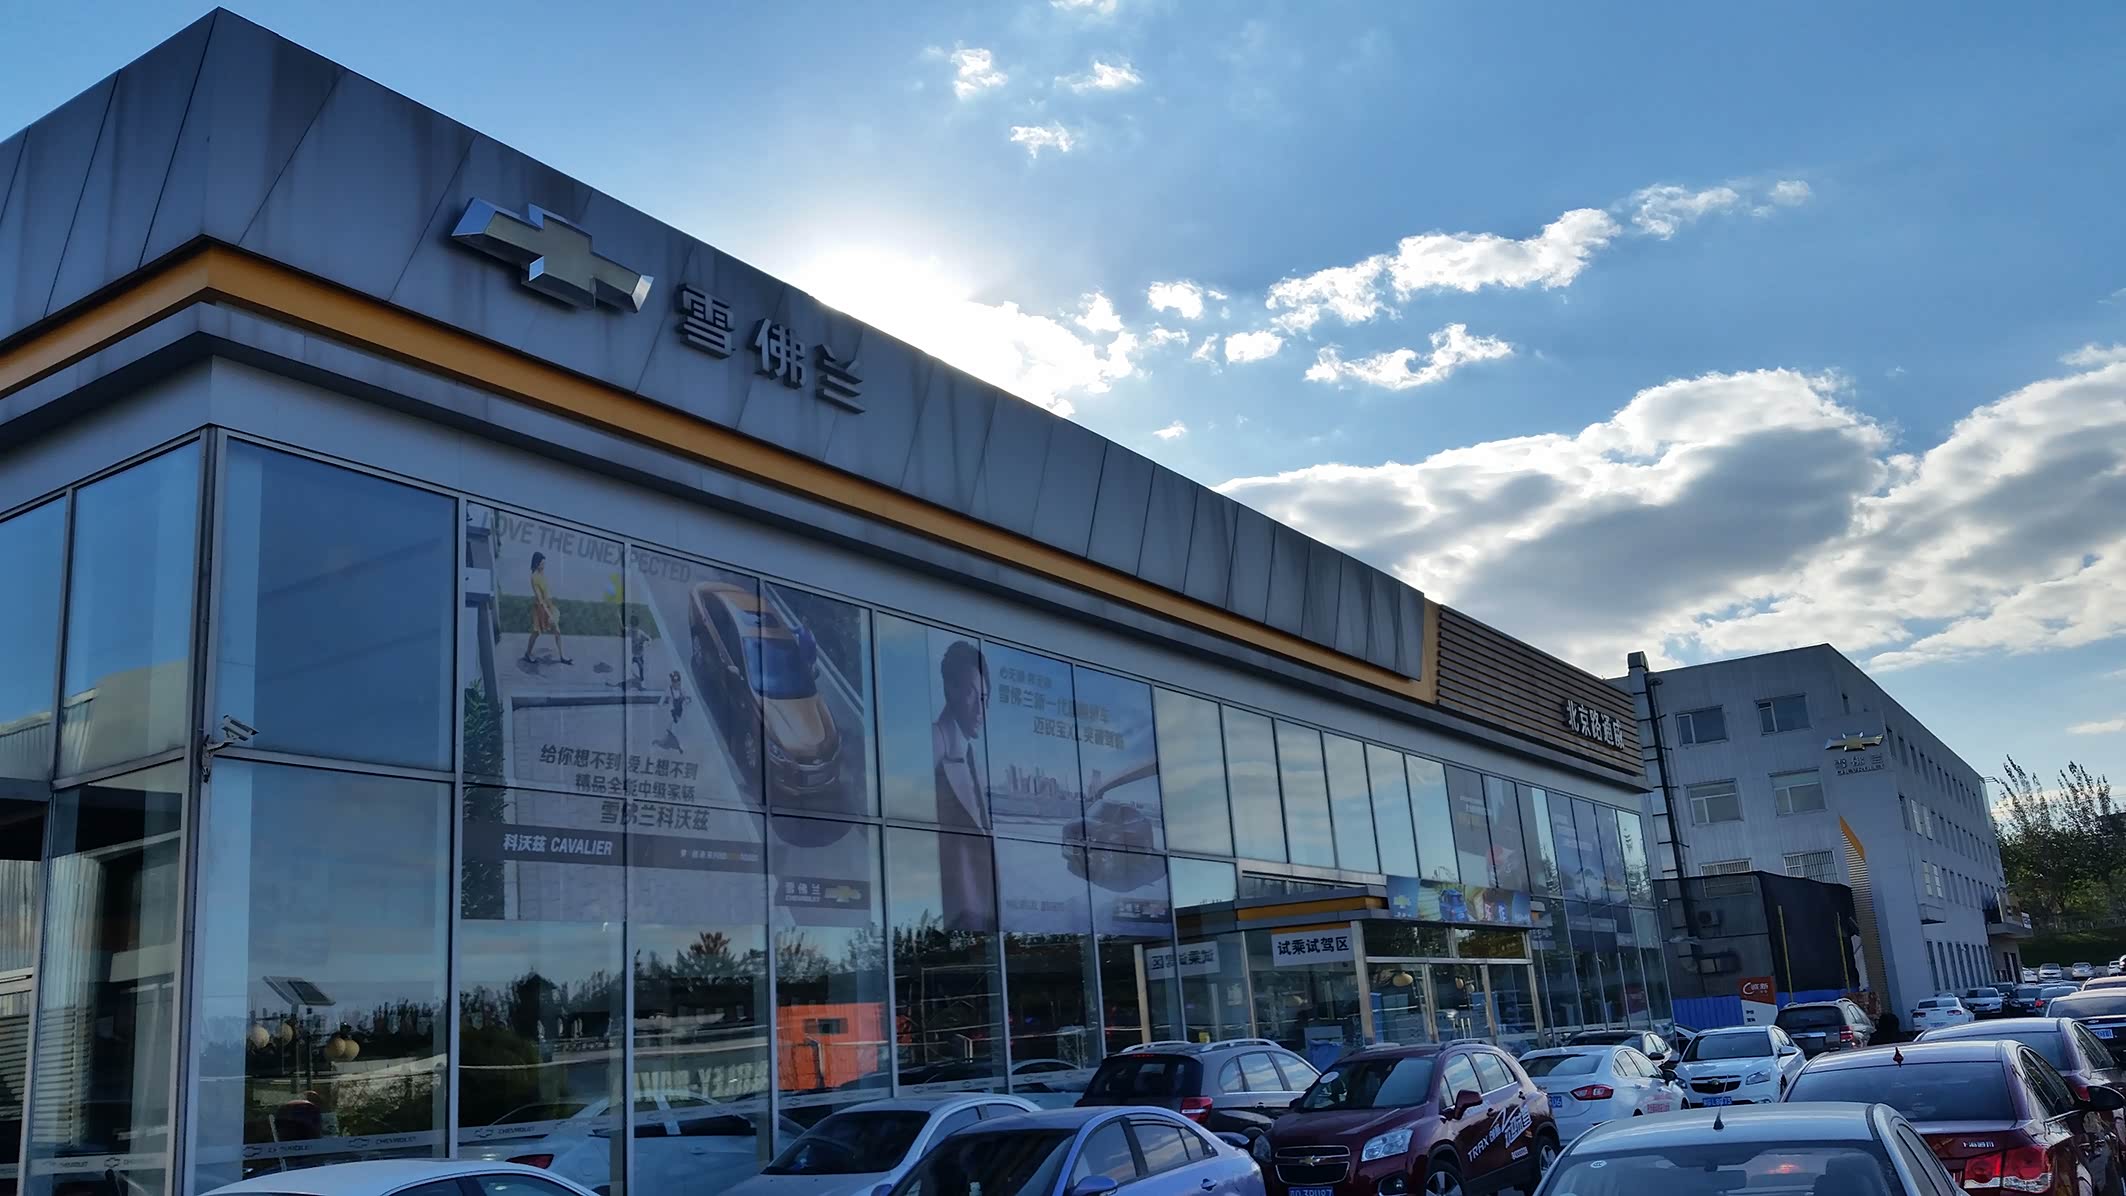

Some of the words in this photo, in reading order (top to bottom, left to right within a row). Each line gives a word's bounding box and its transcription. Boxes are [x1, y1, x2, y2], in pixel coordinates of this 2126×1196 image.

[678, 283, 865, 414] 雪佛兰
[539, 526, 575, 553] THE
[577, 538, 691, 583] UNEXPECTED
[539, 744, 621, 772] 给你想不到
[628, 754, 698, 781] 爱上想不到
[600, 800, 710, 831] 雪佛兰科沃兹
[503, 833, 547, 852] 科沃兹
[551, 837, 613, 855] CAVALIER
[1277, 936, 1350, 956] 试乘试驾区
[1467, 1135, 1490, 1163] TRAX
